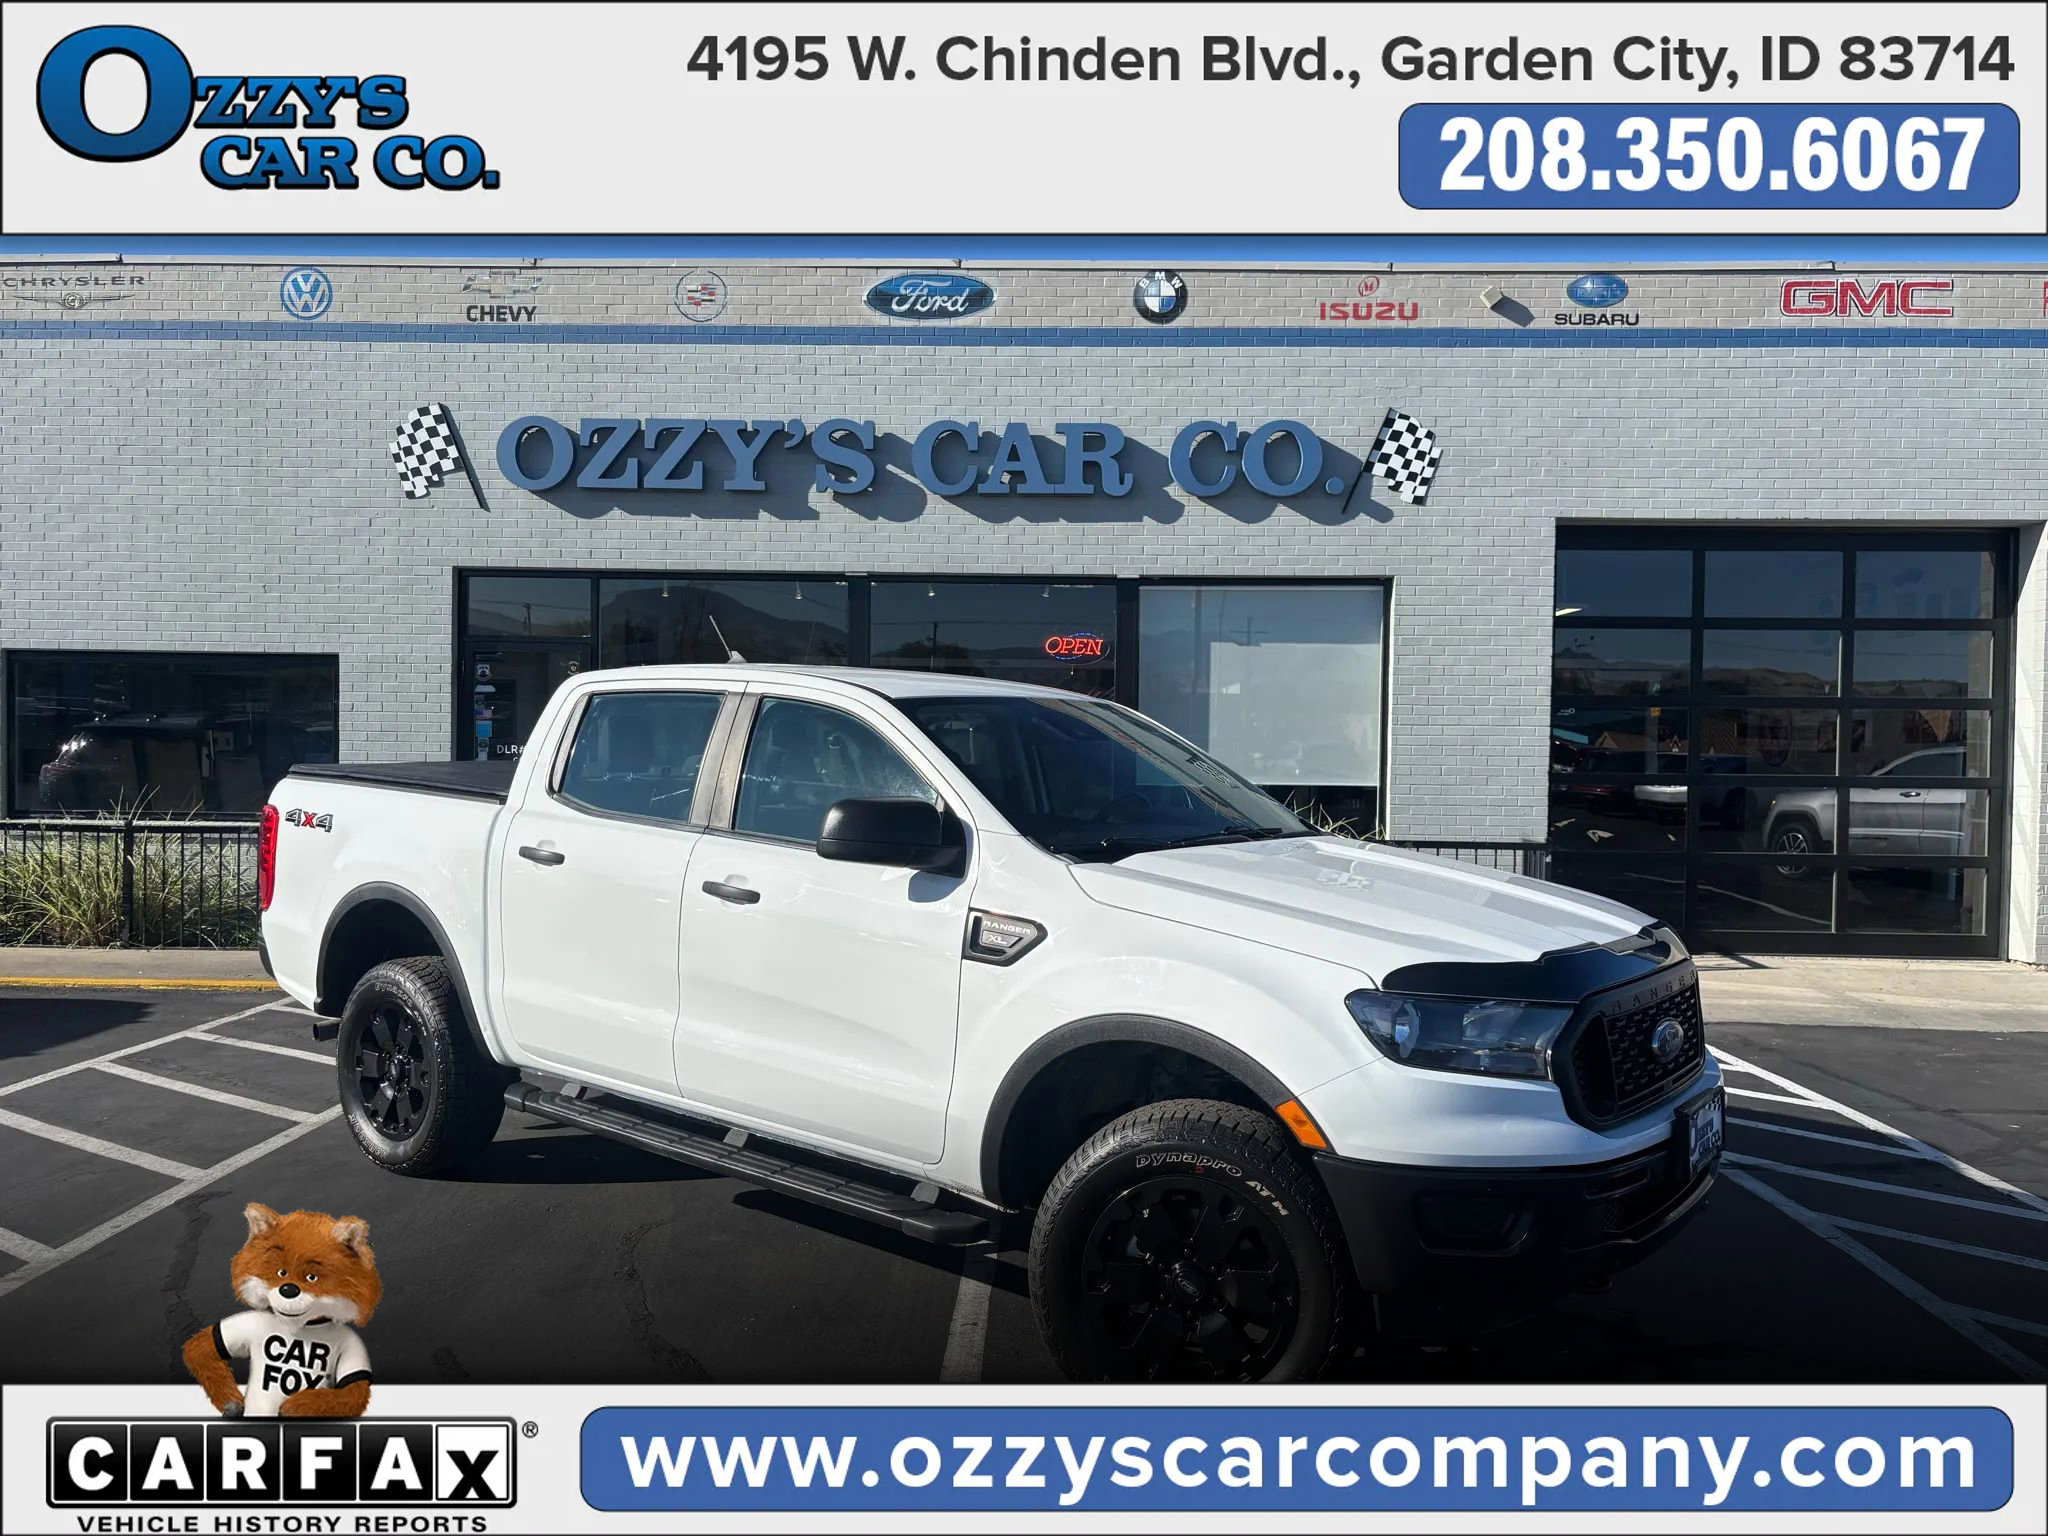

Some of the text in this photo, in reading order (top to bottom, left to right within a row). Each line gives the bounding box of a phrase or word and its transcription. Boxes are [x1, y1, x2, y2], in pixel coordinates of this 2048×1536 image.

[3, 276, 146, 288] CHRYSLER
[1138, 271, 1183, 290] BMW
[891, 279, 970, 312] Ford
[1781, 279, 1953, 317] GMC
[466, 304, 537, 322] CHEVY
[1320, 302, 1418, 320] ISUZU
[1555, 313, 1639, 326] SUBARU
[496, 416, 1345, 497] OZZY'S CAR CO.
[1045, 636, 1104, 655] OPEN
[983, 920, 1031, 934] RANGER
